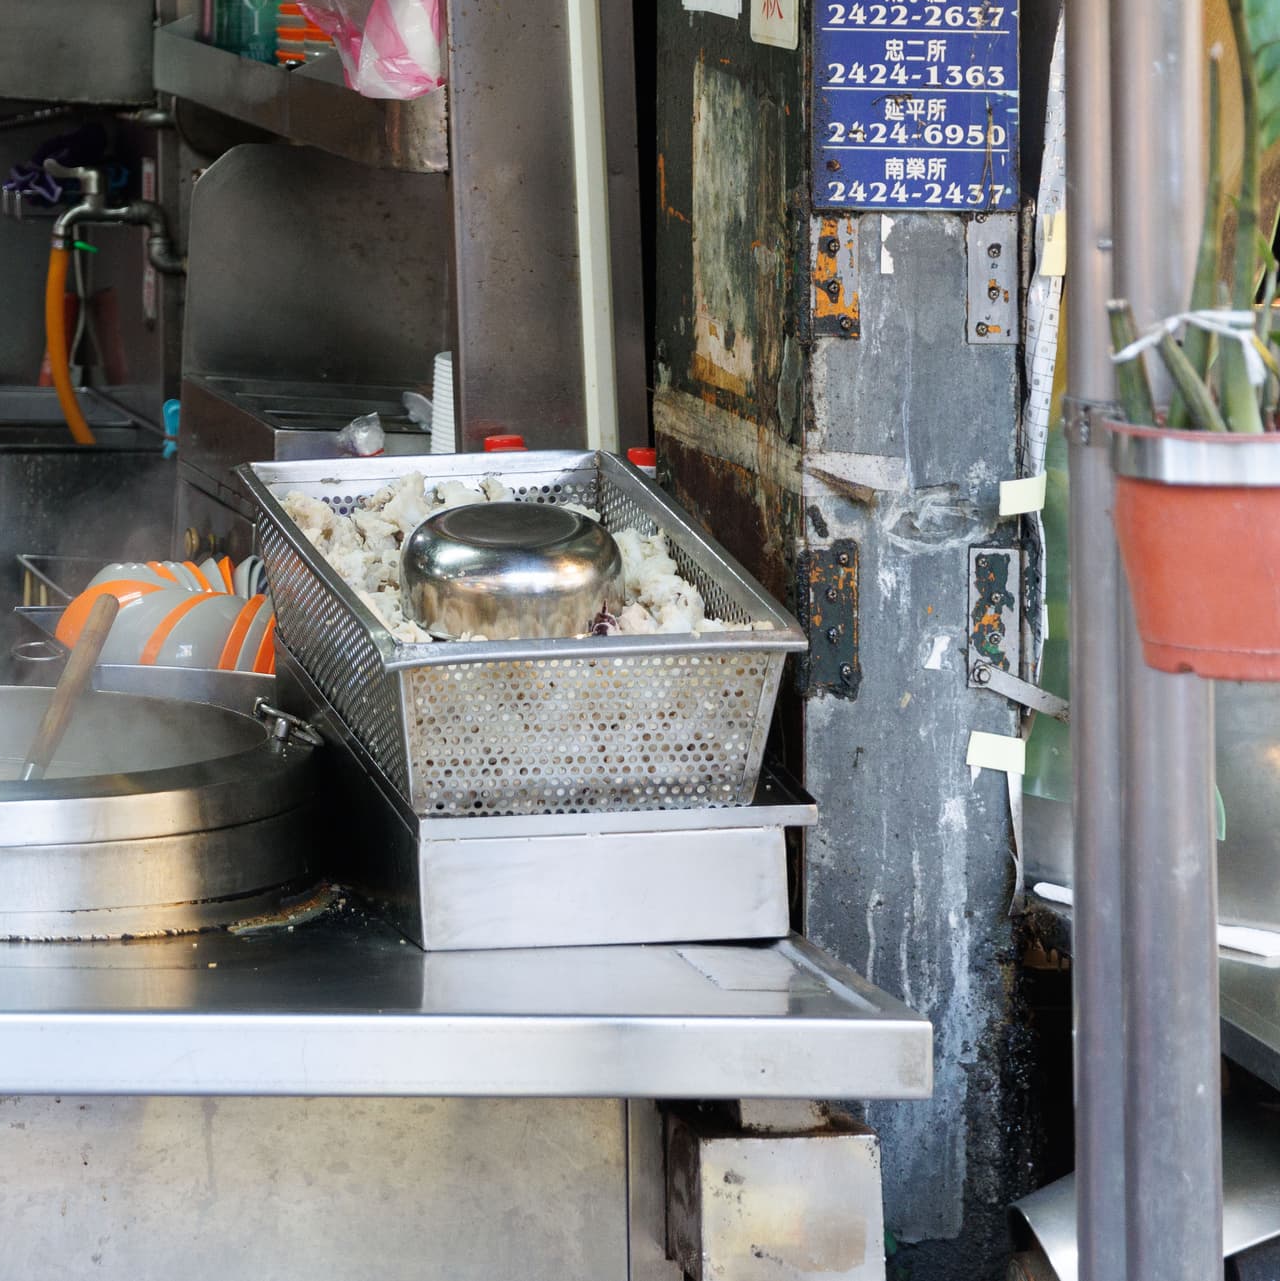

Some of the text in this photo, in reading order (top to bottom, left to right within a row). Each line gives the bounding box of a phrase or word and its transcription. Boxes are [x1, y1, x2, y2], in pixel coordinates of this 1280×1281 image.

[827, 5, 1005, 29] 2422-2637
[884, 38, 947, 63] 忠二所
[828, 64, 1006, 87] 2424-1363
[884, 98, 947, 123] 延平所
[827, 124, 1006, 146] 2424-6950
[884, 157, 947, 182] 南榮所
[827, 183, 1006, 206] 2424-2437
